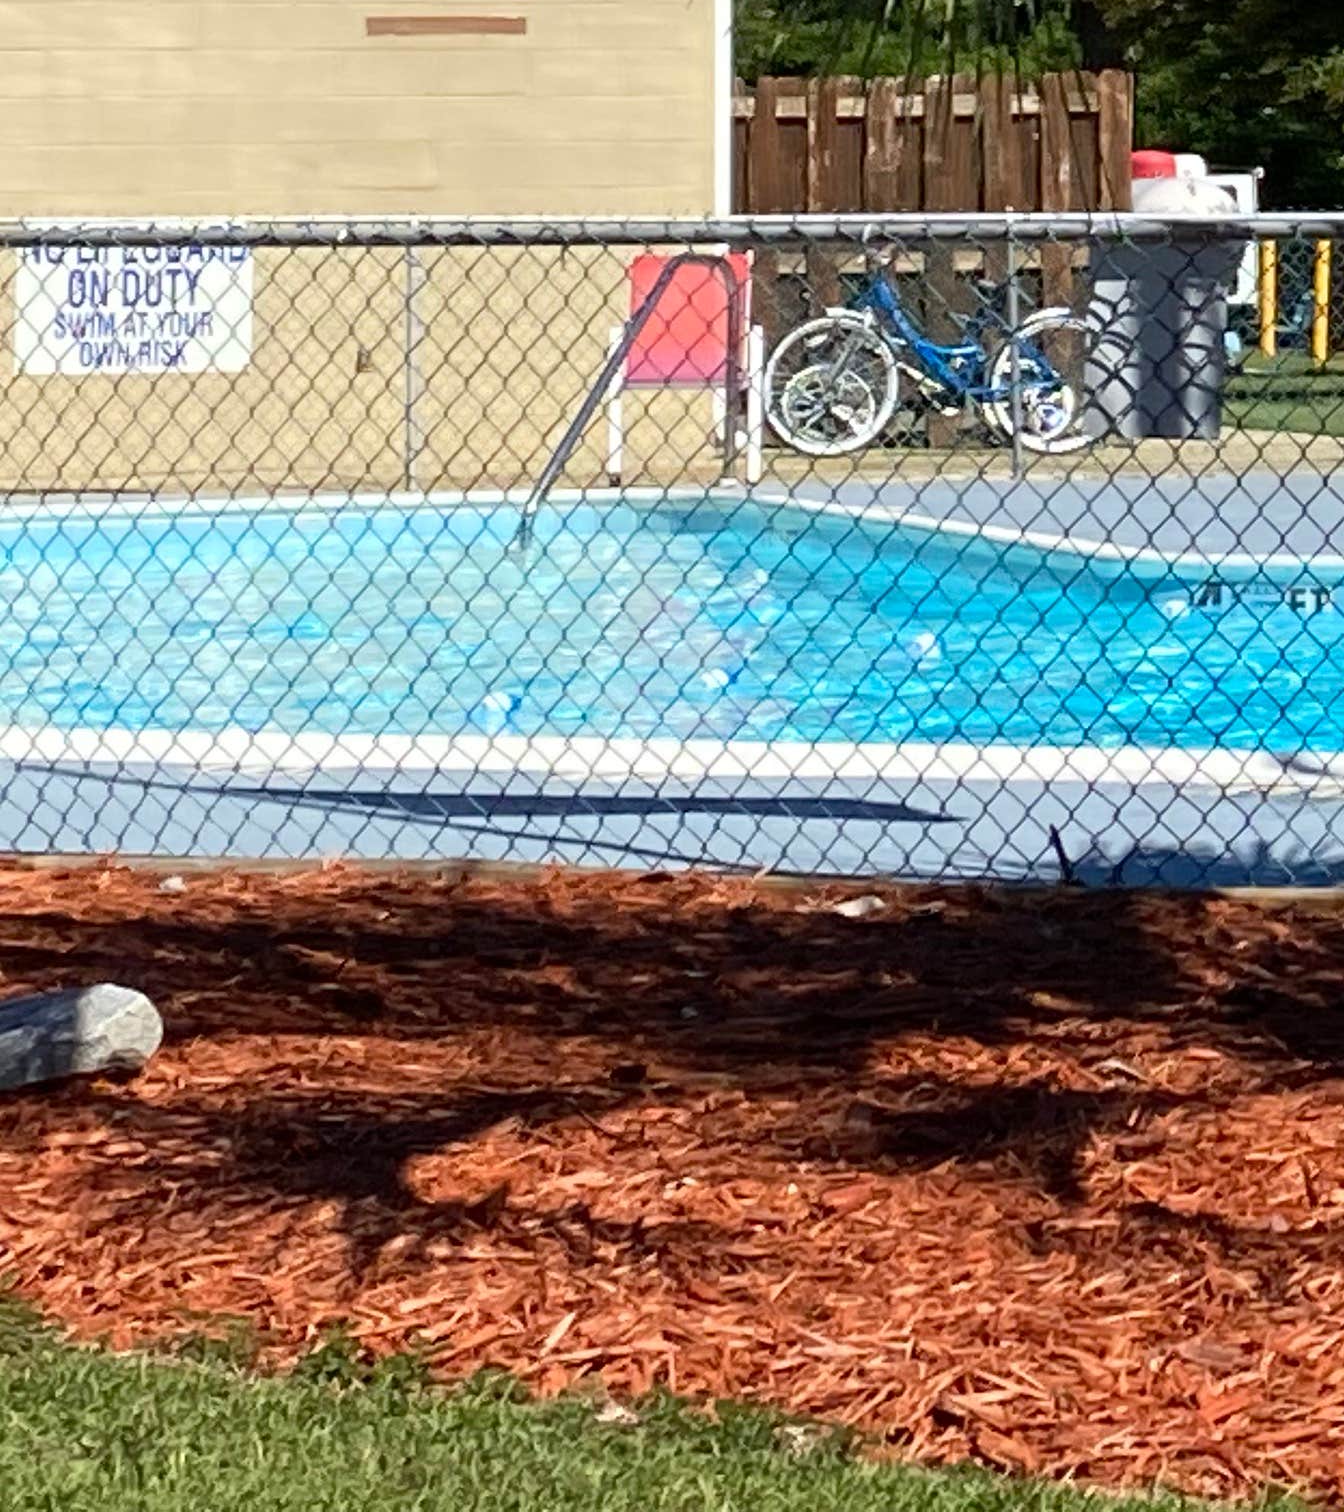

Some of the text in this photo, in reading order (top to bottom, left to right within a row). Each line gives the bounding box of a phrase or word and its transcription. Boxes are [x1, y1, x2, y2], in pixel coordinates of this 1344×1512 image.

[67, 267, 202, 308] ON DUTY
[54, 311, 214, 339] SWIM AT YOUR
[80, 340, 188, 368] OWN RISK
